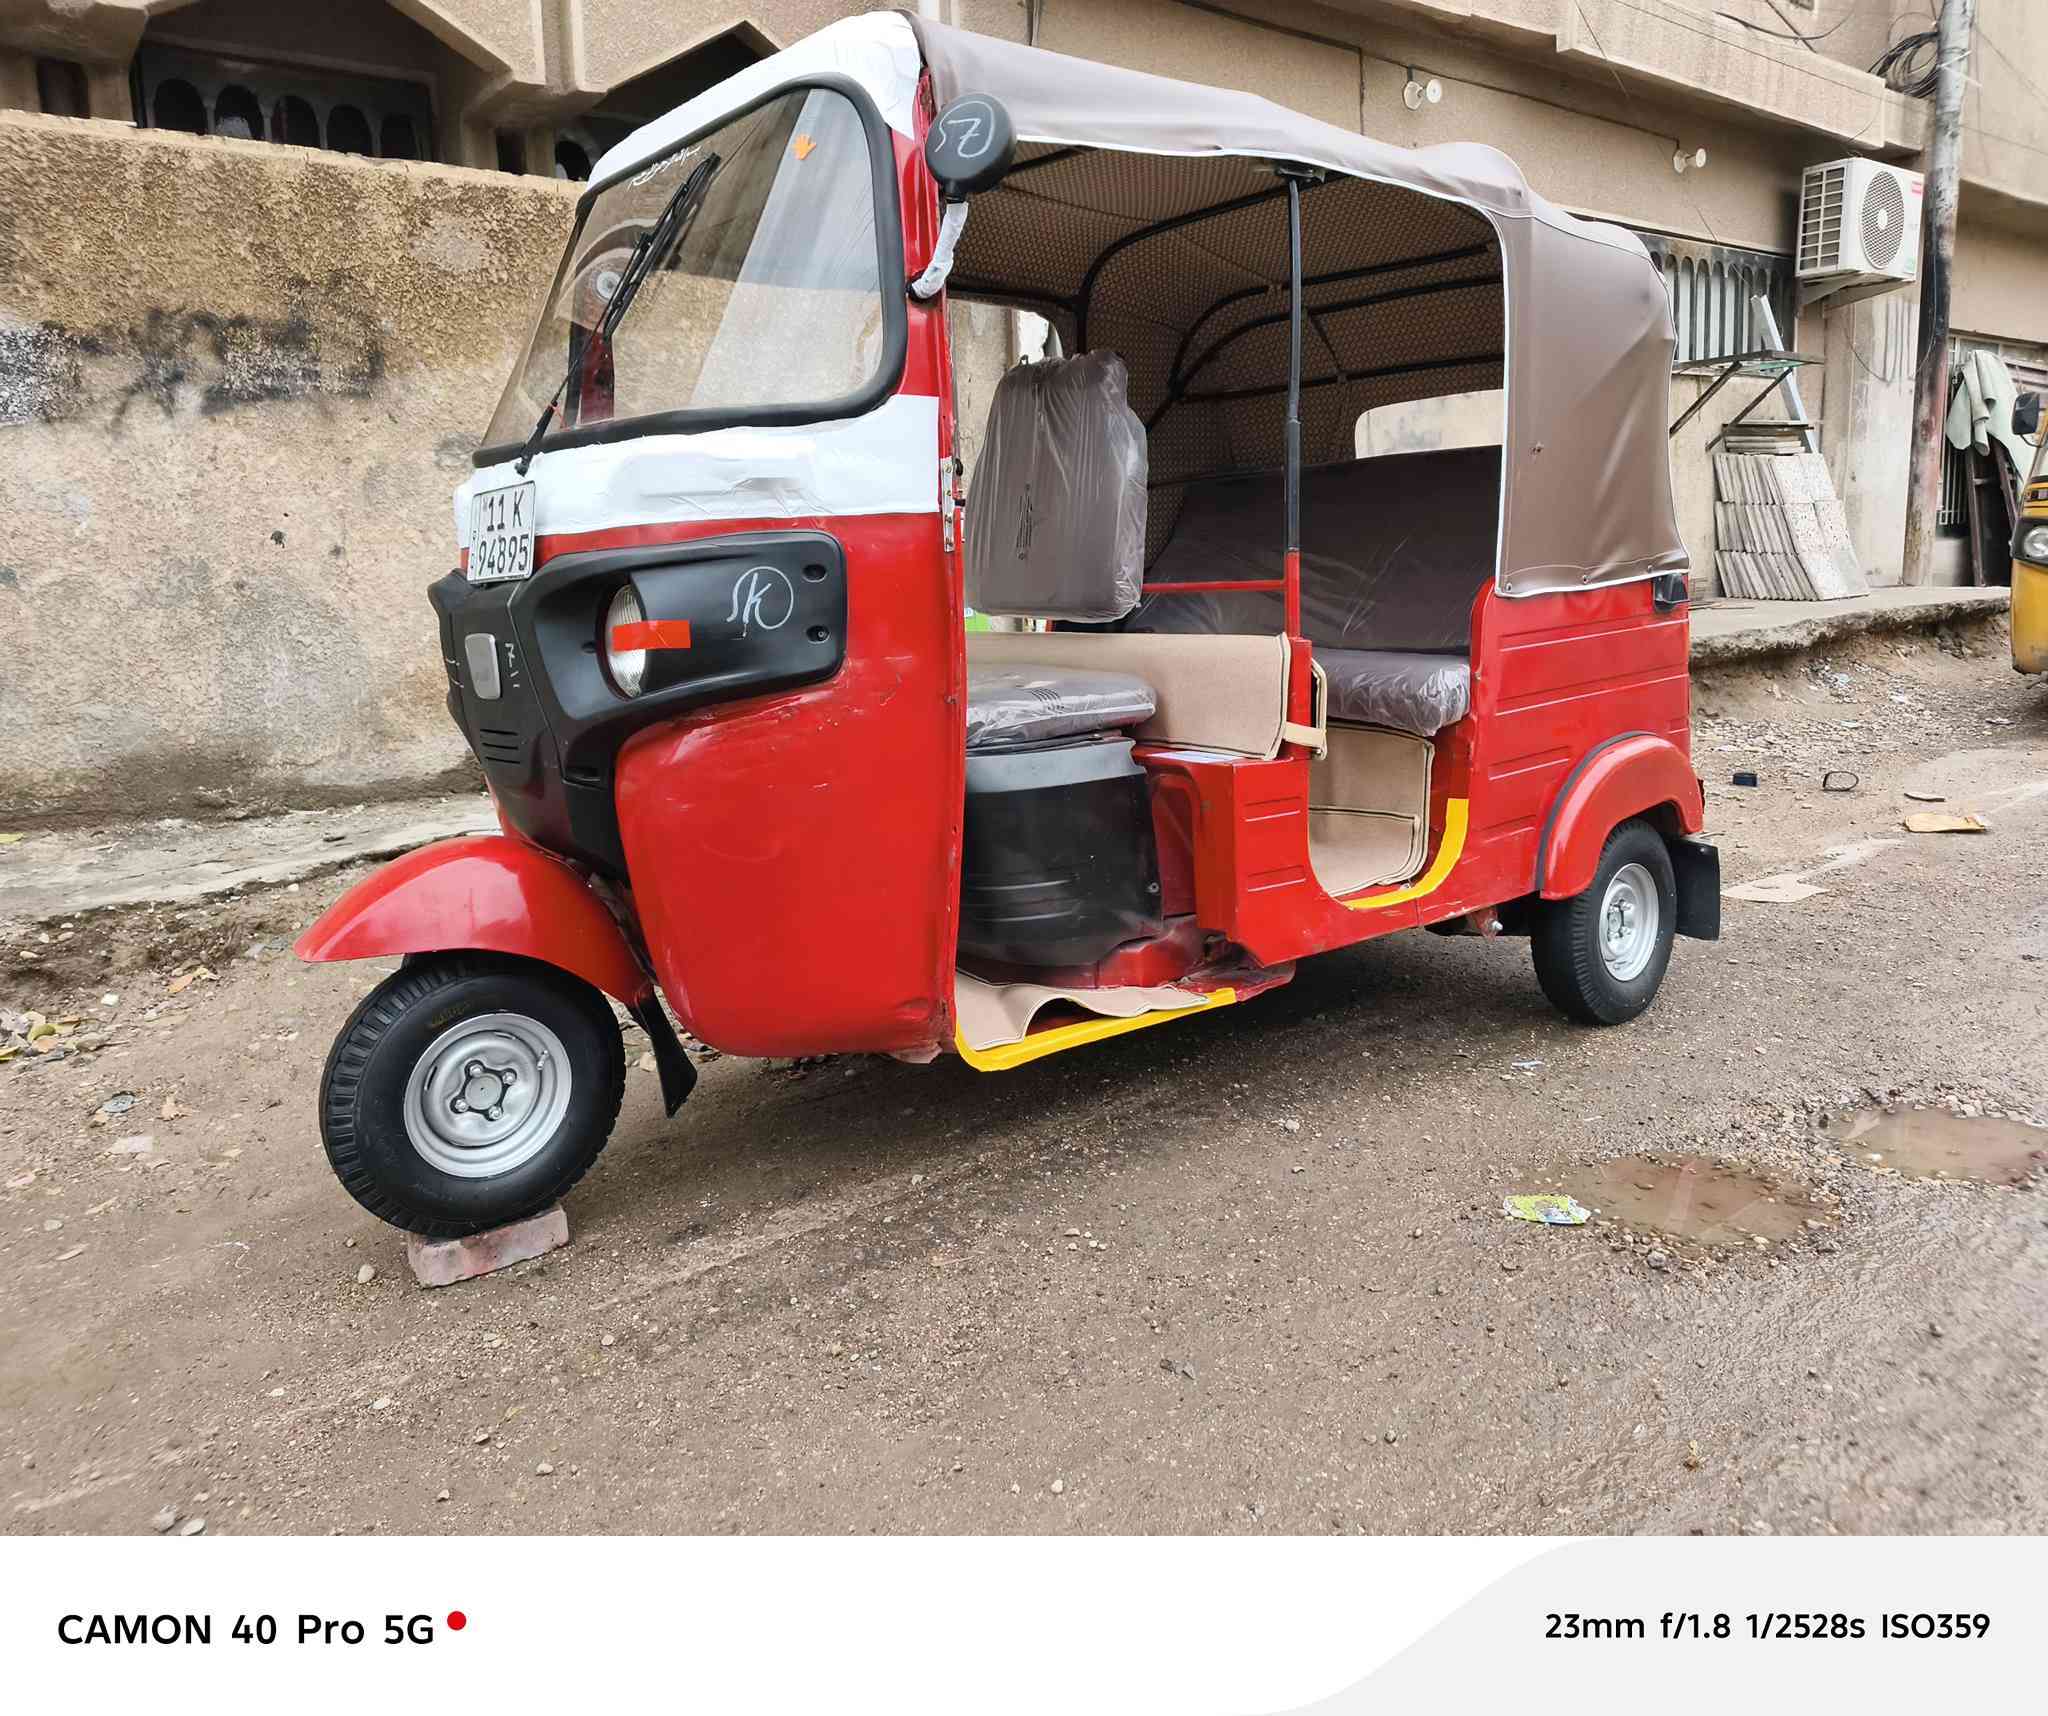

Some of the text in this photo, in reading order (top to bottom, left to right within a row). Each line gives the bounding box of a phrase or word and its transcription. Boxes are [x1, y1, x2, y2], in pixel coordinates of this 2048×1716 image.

[486, 489, 525, 532] 11 K
[479, 533, 529, 576] 94895
